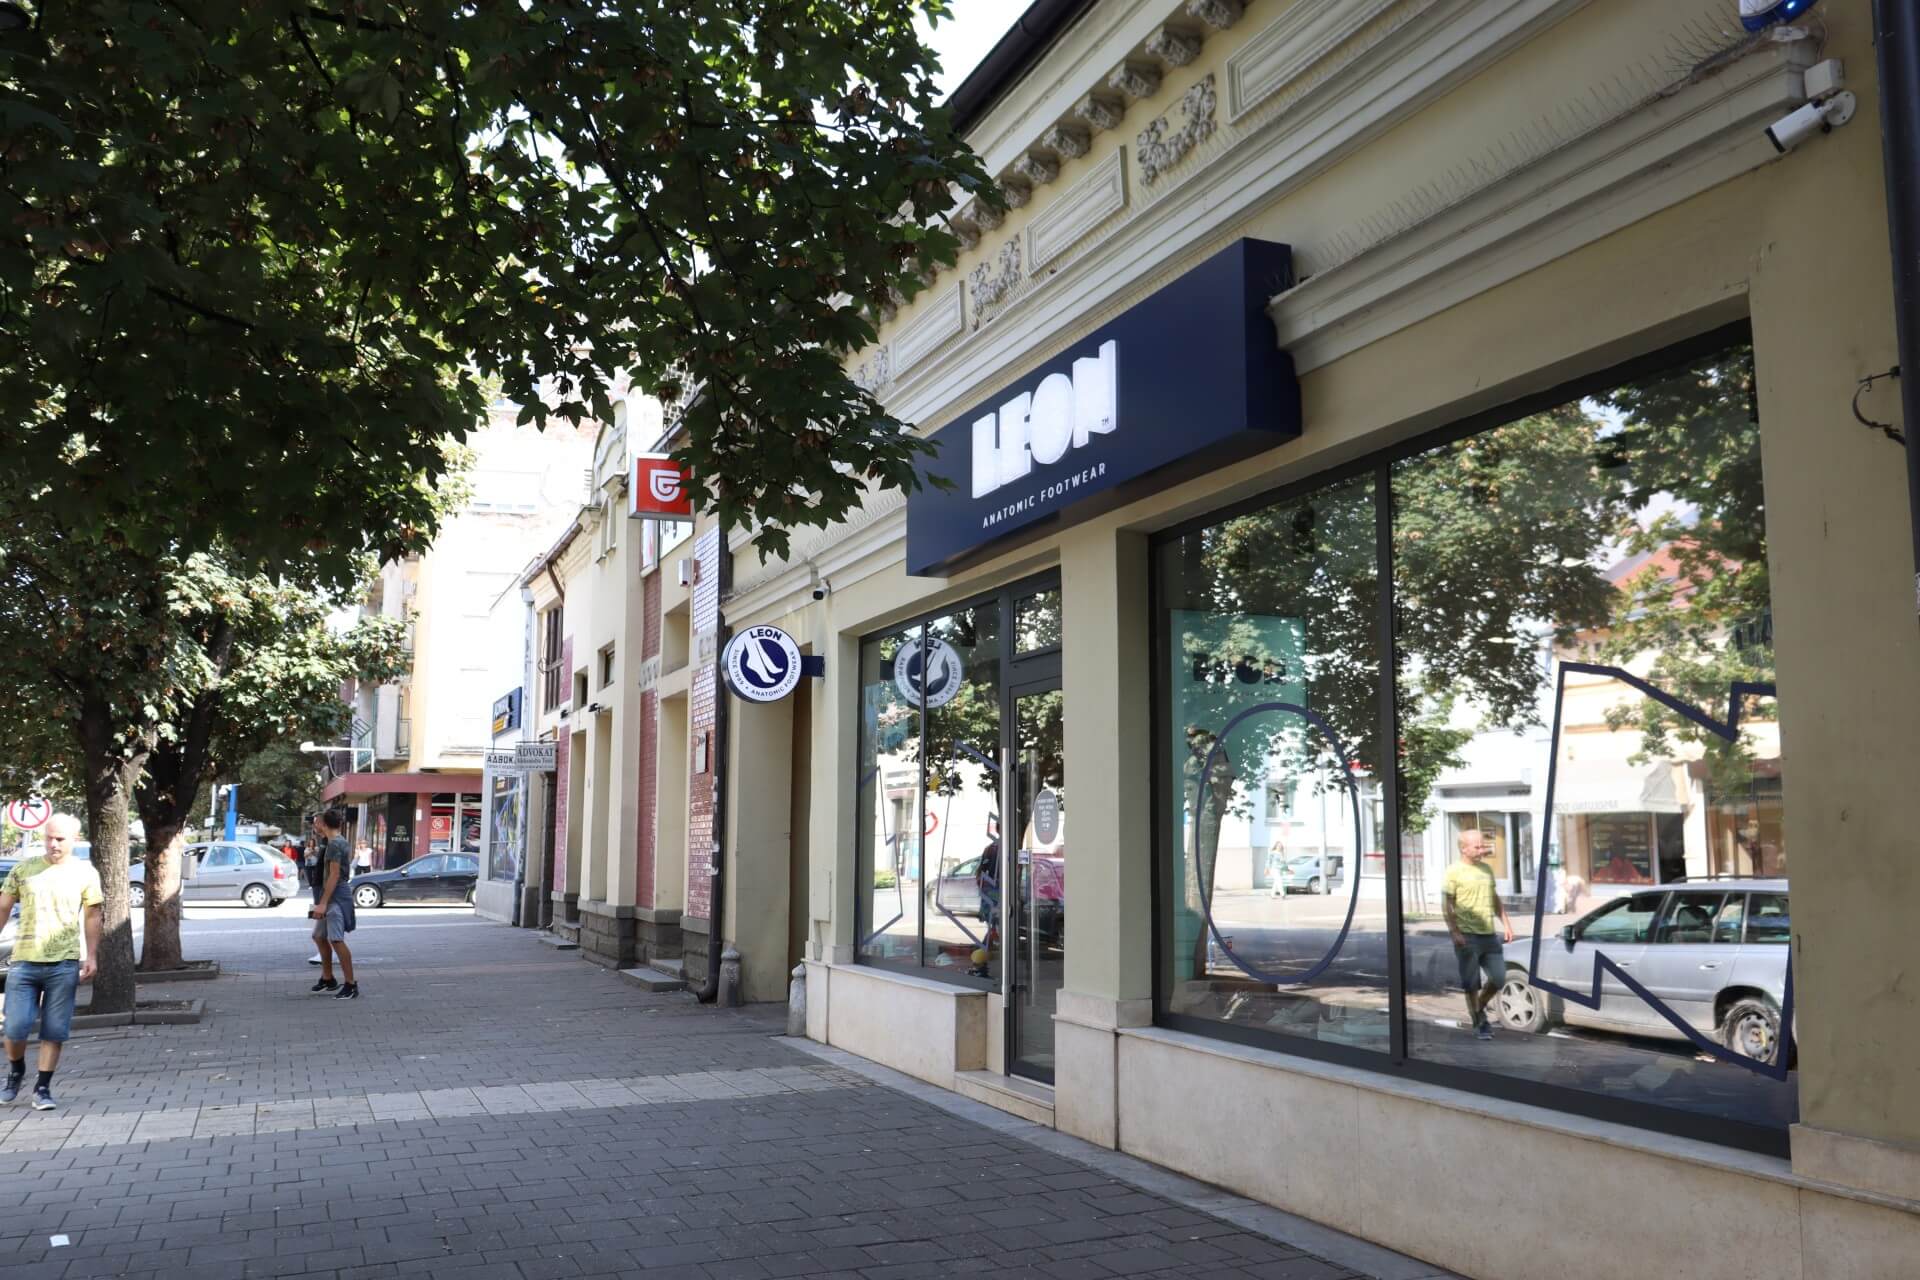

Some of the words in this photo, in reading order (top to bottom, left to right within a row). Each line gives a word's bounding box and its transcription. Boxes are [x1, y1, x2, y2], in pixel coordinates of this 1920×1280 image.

[972, 339, 1117, 499] LEON
[983, 496, 1035, 528] ANATOMIC
[1040, 463, 1106, 502] FOOTWEAR
[750, 628, 782, 640] LEON
[751, 686, 785, 697] ANATOMIC
[785, 651, 797, 687] FOOTWEAR
[517, 747, 553, 757] ADVOKAT
